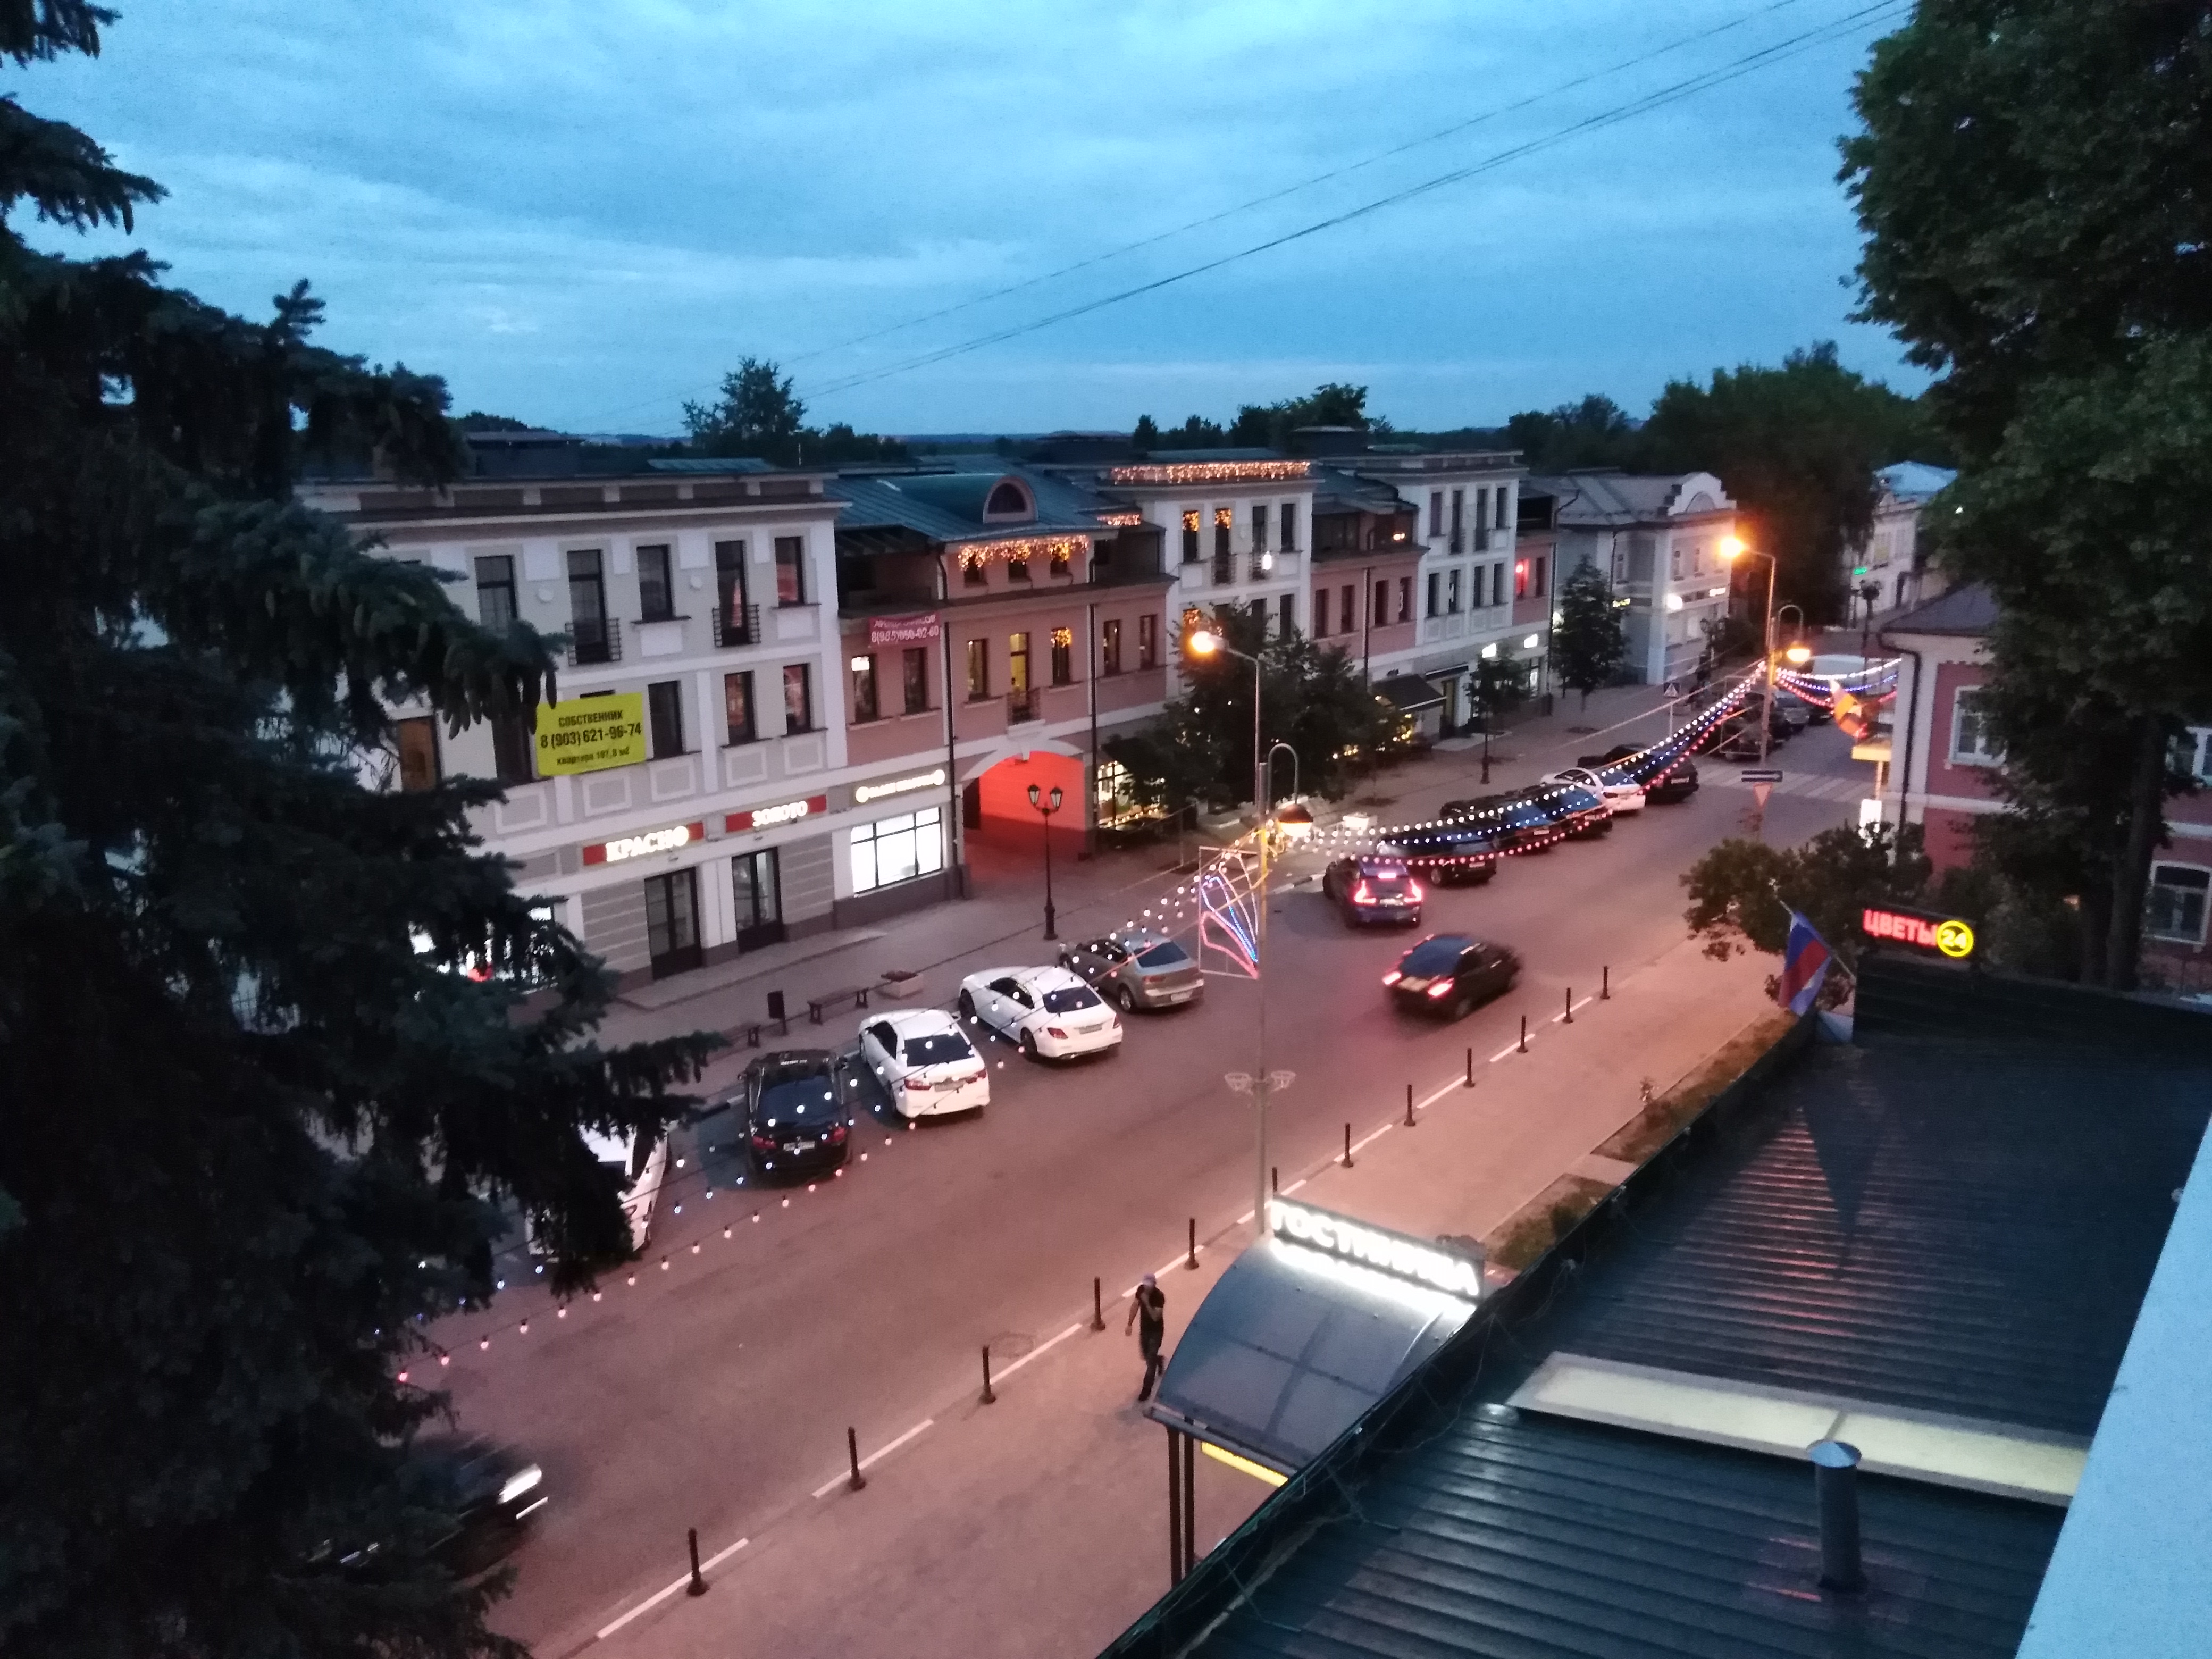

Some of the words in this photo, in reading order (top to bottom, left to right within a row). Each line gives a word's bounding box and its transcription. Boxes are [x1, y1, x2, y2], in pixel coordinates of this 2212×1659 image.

[559, 710, 624, 727] СОБСТВЕННИК
[540, 734, 548, 748] 8
[551, 731, 581, 749] (903)
[1863, 909, 1939, 946] ЦВЕТЫ
[1941, 929, 1967, 949] 24
